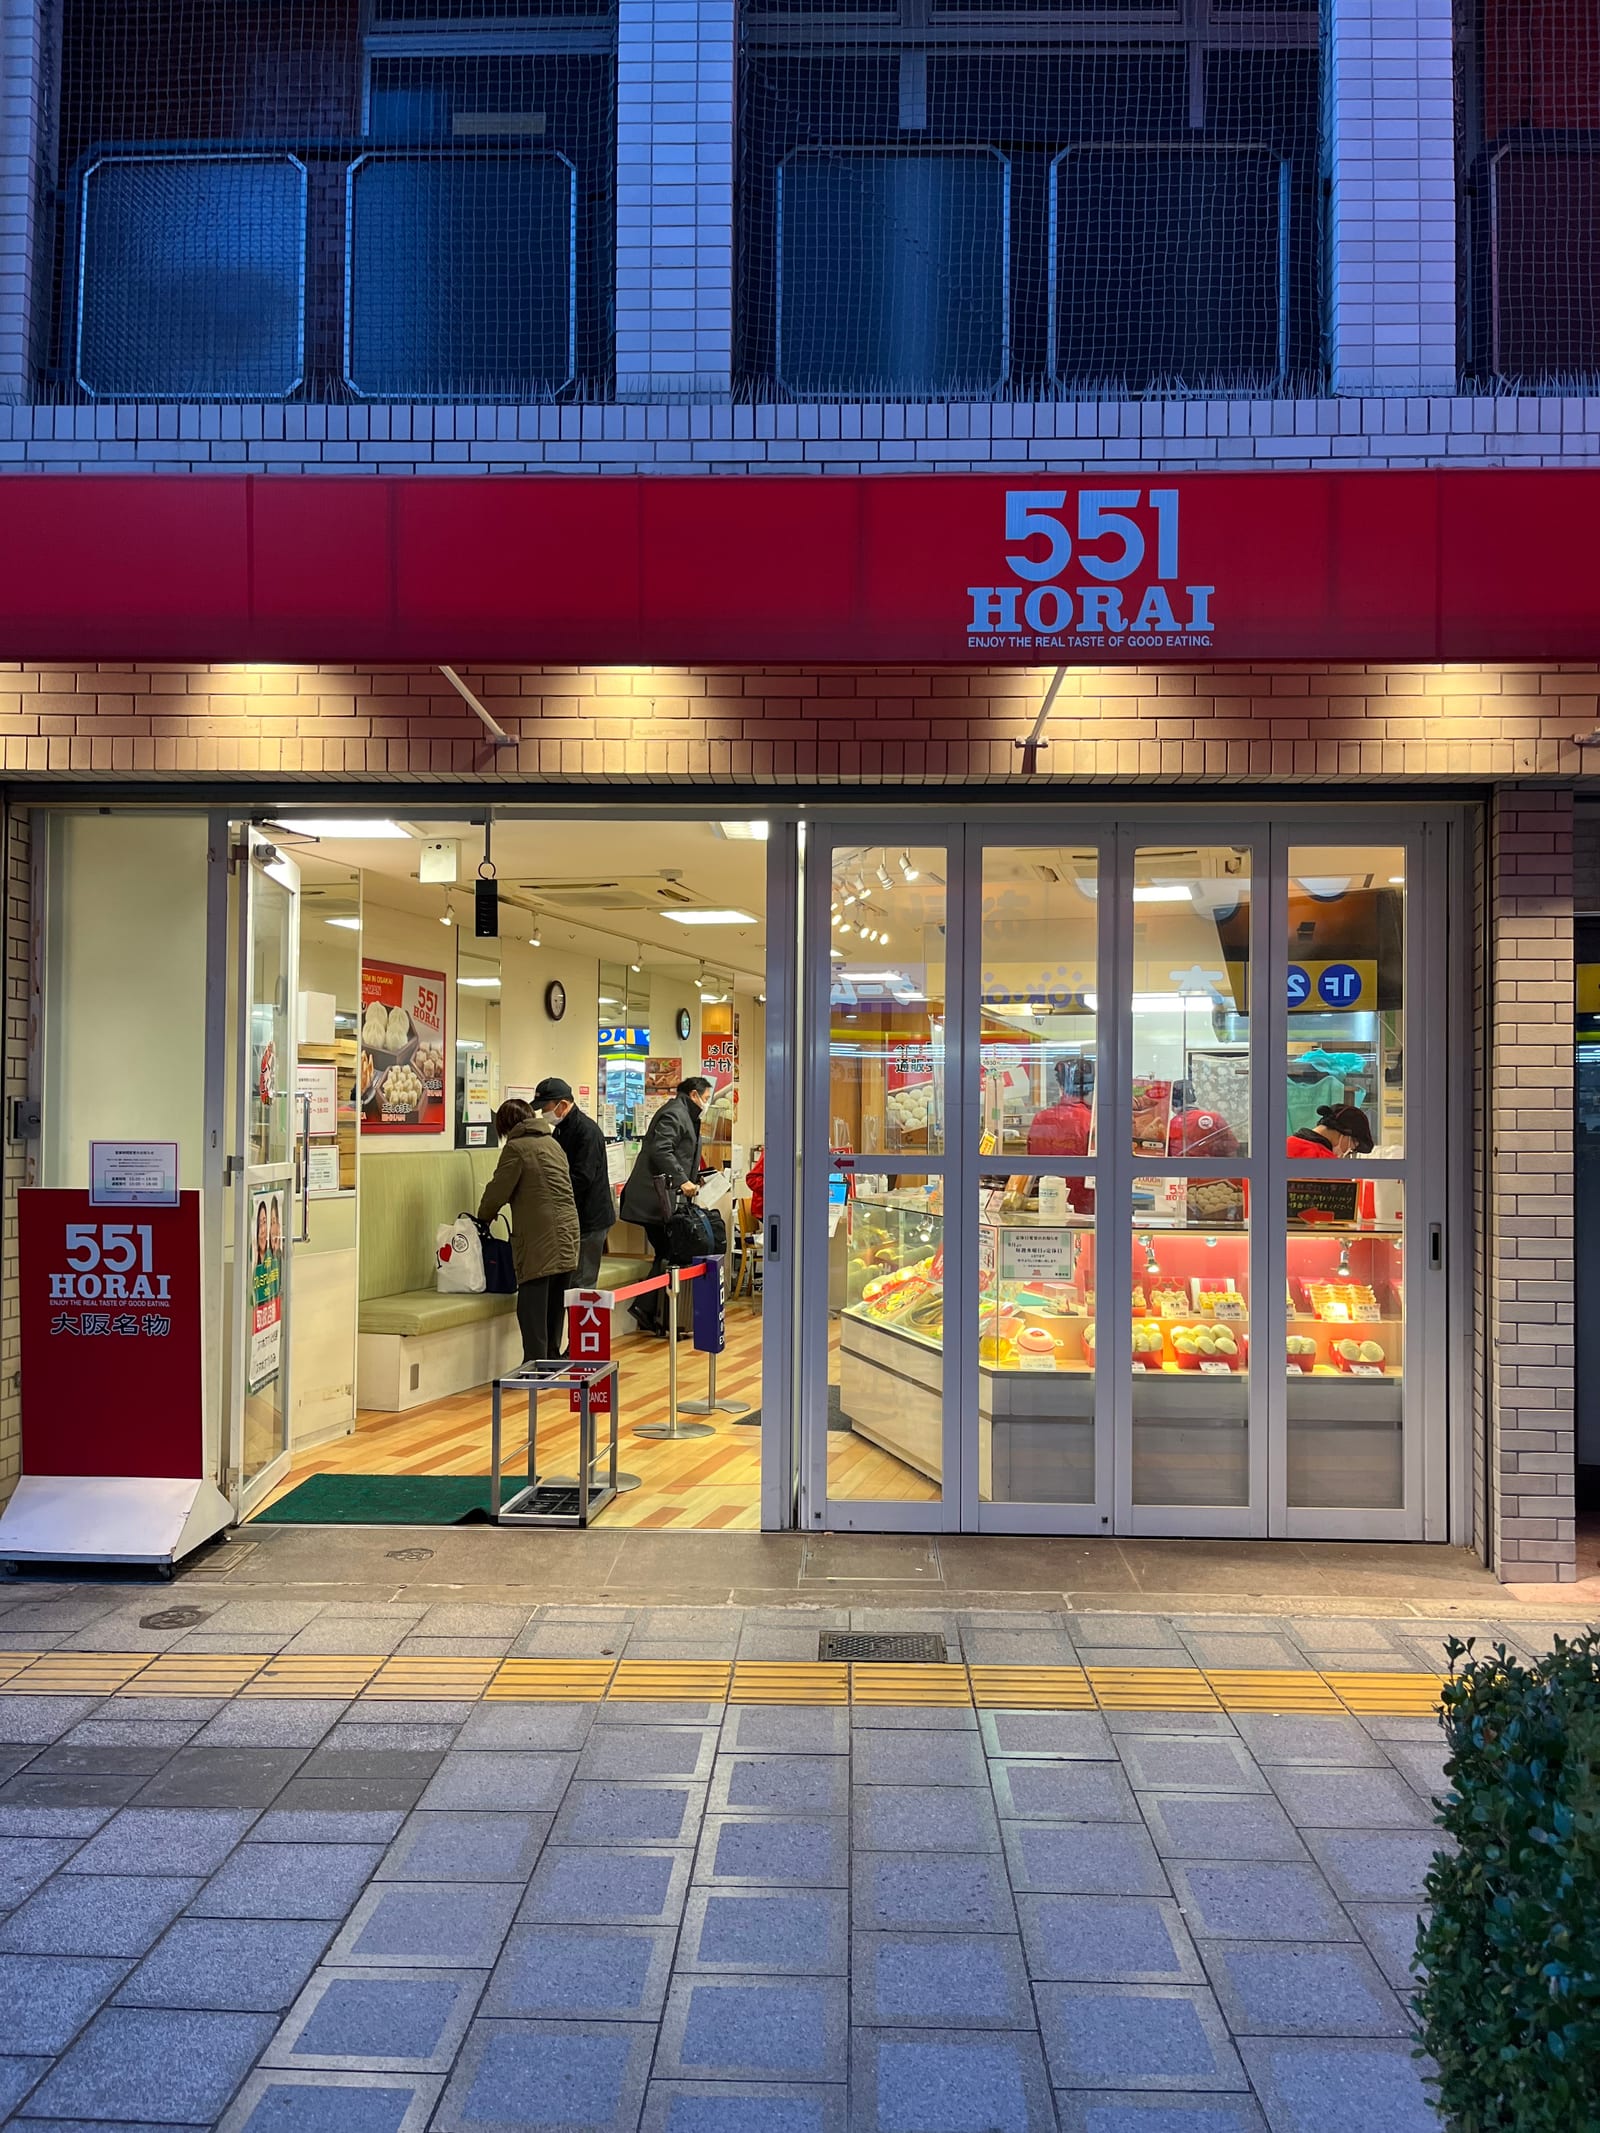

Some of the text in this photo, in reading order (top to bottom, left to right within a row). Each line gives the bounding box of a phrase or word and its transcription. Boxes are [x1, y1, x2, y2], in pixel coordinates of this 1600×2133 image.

[1005, 489, 1179, 581] 551
[967, 585, 1215, 633] HORAI
[968, 635, 1213, 648] ENJOY THE REAL TASTE OF GOOD EATING.
[418, 986, 438, 1015] 551
[413, 1005, 440, 1030] HORAI
[66, 1223, 153, 1272] 551
[49, 1274, 171, 1299] HORAI
[50, 1311, 171, 1336] 大阪名物
[579, 1305, 602, 1353] 入口
